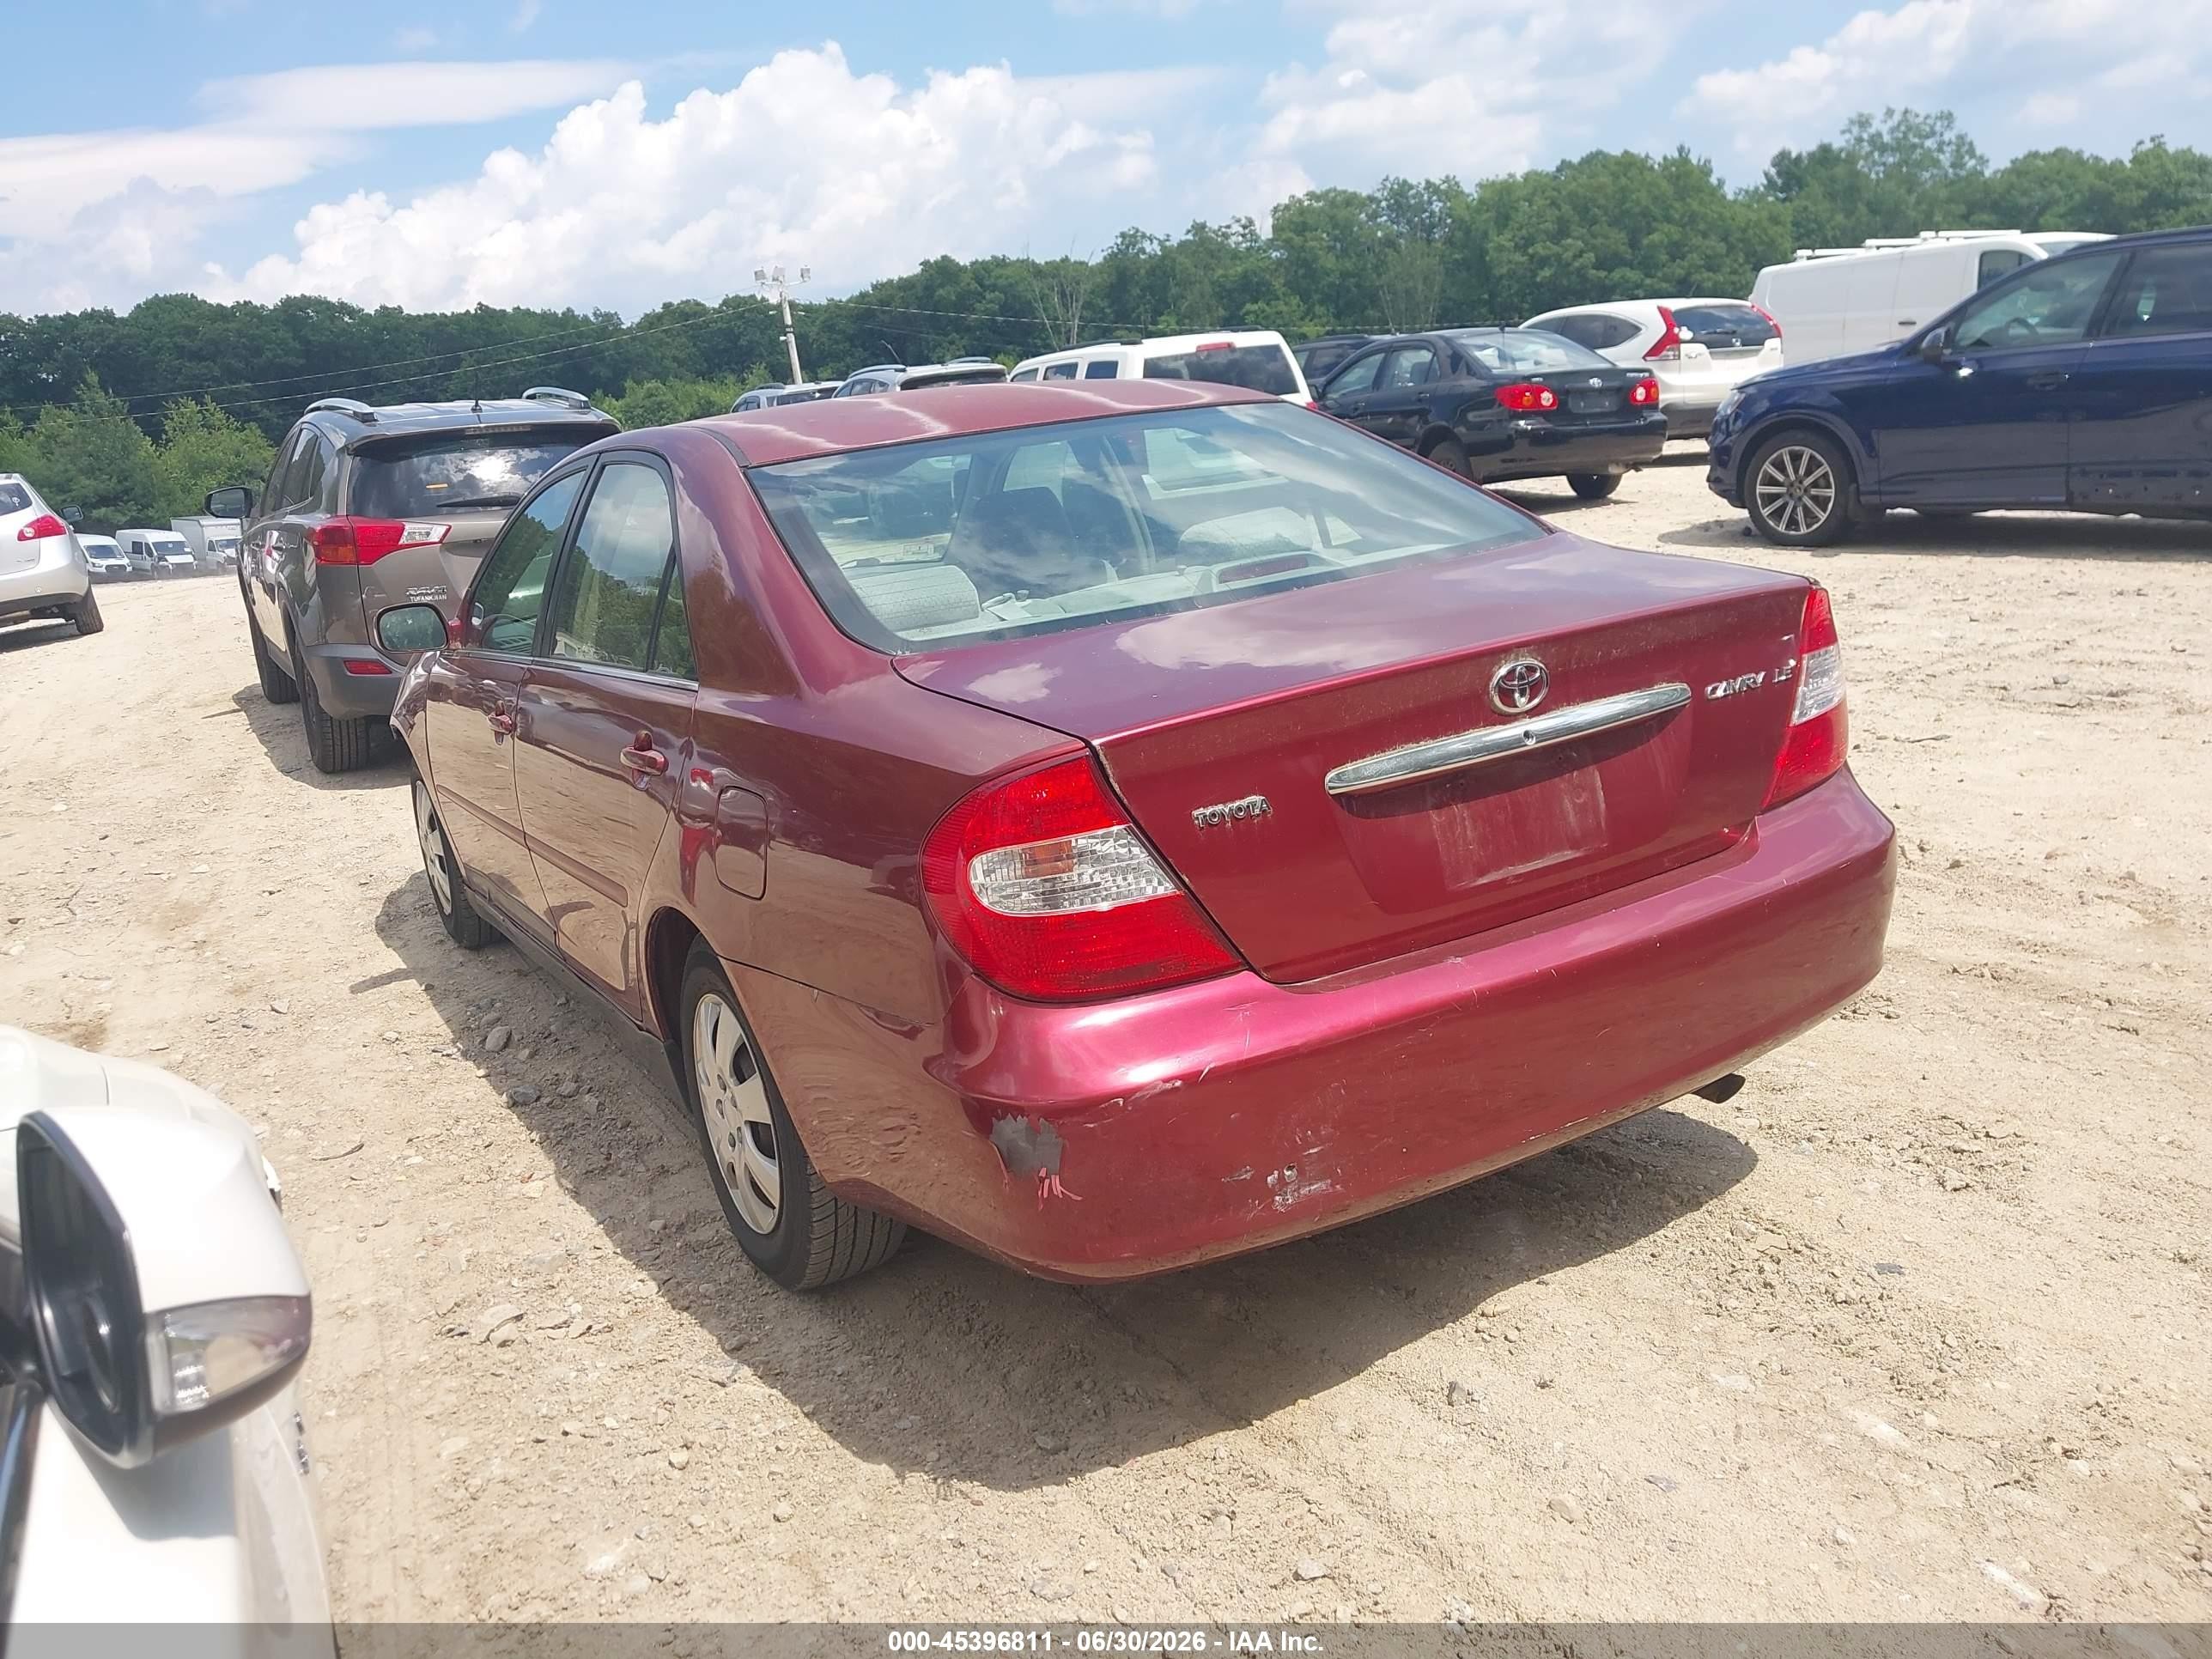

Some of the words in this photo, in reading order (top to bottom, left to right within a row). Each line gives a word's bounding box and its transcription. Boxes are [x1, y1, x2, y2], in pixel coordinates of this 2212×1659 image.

[405, 585, 447, 595] RAV4
[1705, 671, 1766, 700] CAMRY
[1771, 665, 1794, 684] LE
[1191, 795, 1273, 828] TOYOTA
